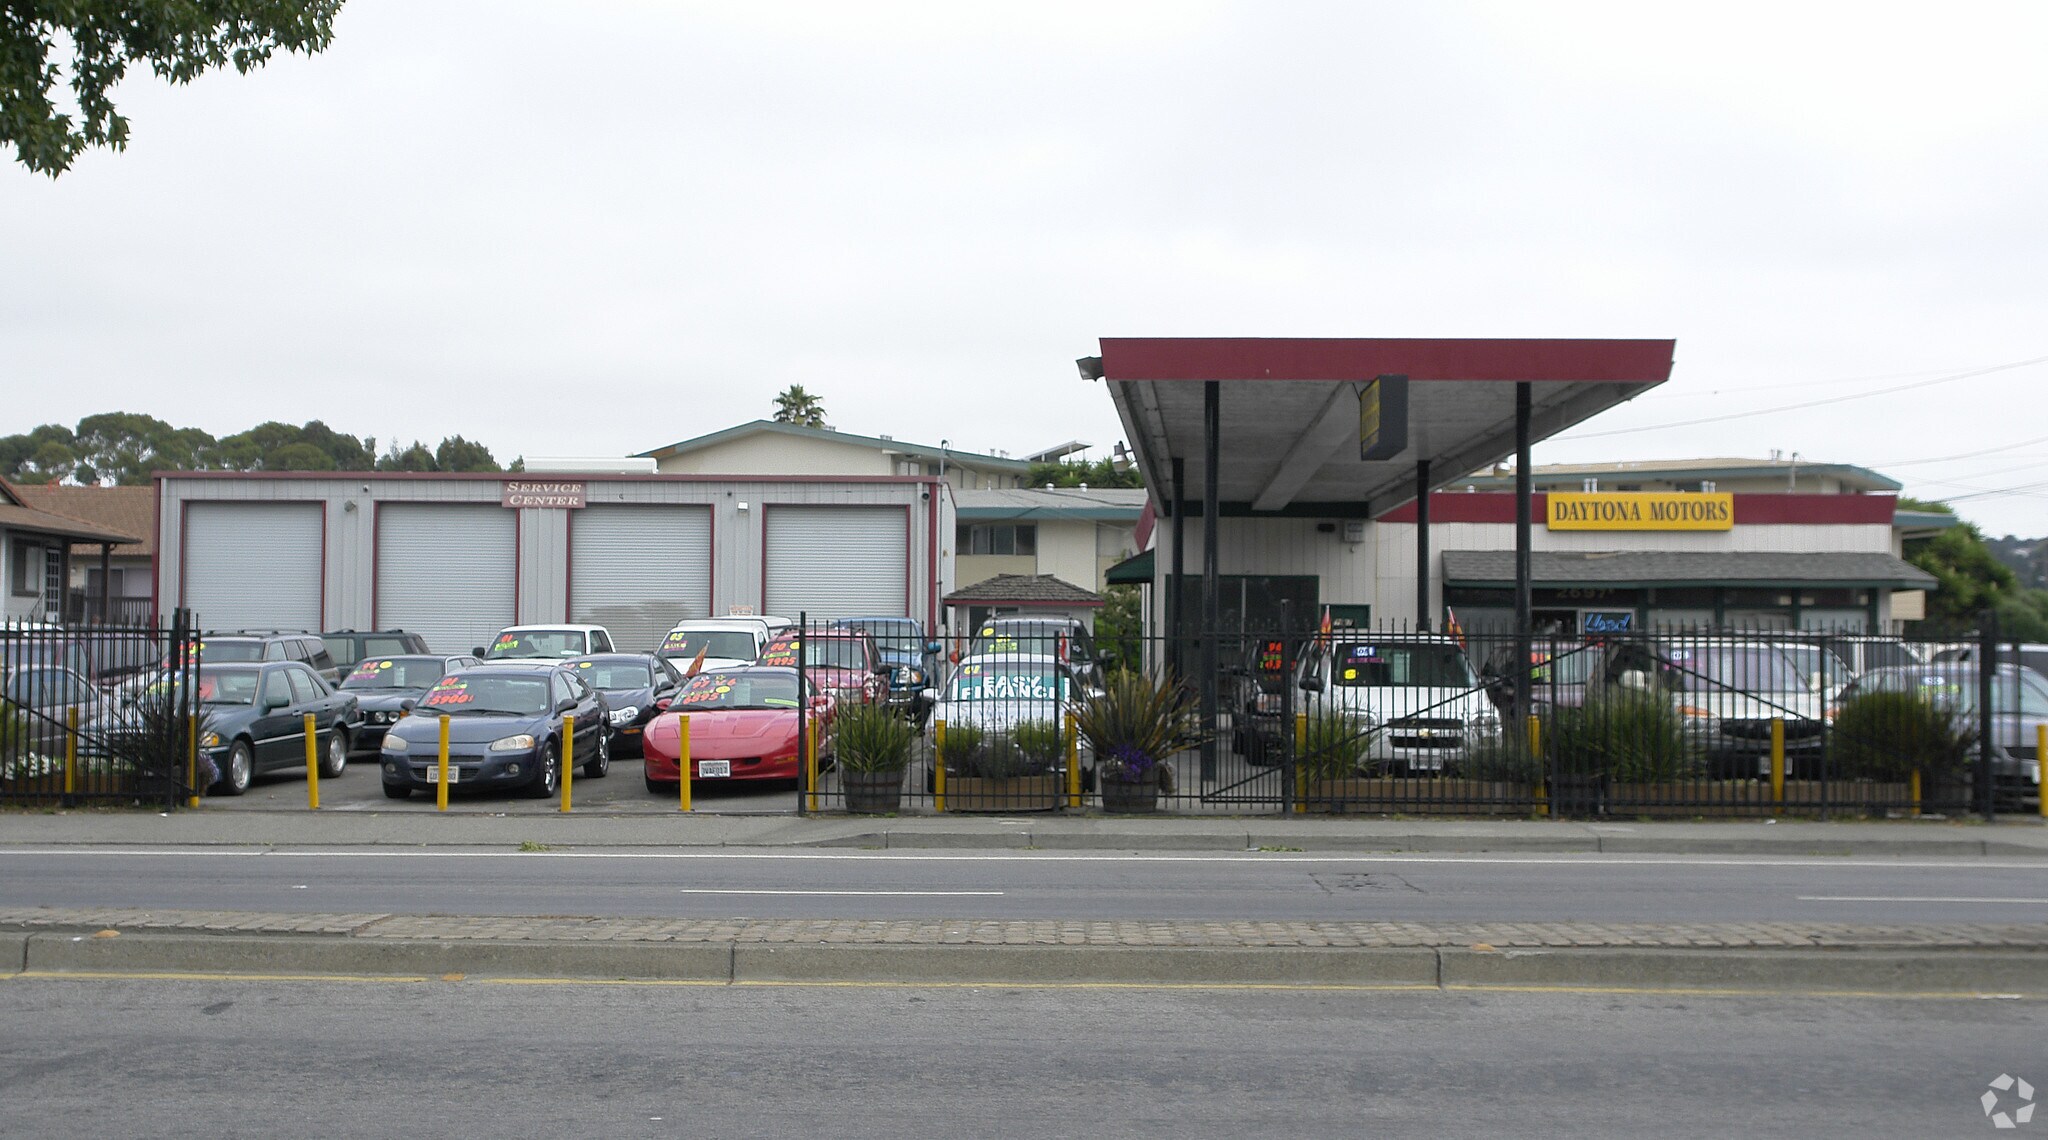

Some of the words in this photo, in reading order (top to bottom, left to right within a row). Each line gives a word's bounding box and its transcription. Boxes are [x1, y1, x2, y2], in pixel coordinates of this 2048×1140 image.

[506, 481, 581, 493] SERVICE
[509, 495, 578, 506] CENTER
[1555, 501, 1641, 521] DAYTONA
[1650, 501, 1728, 521] MOTORS
